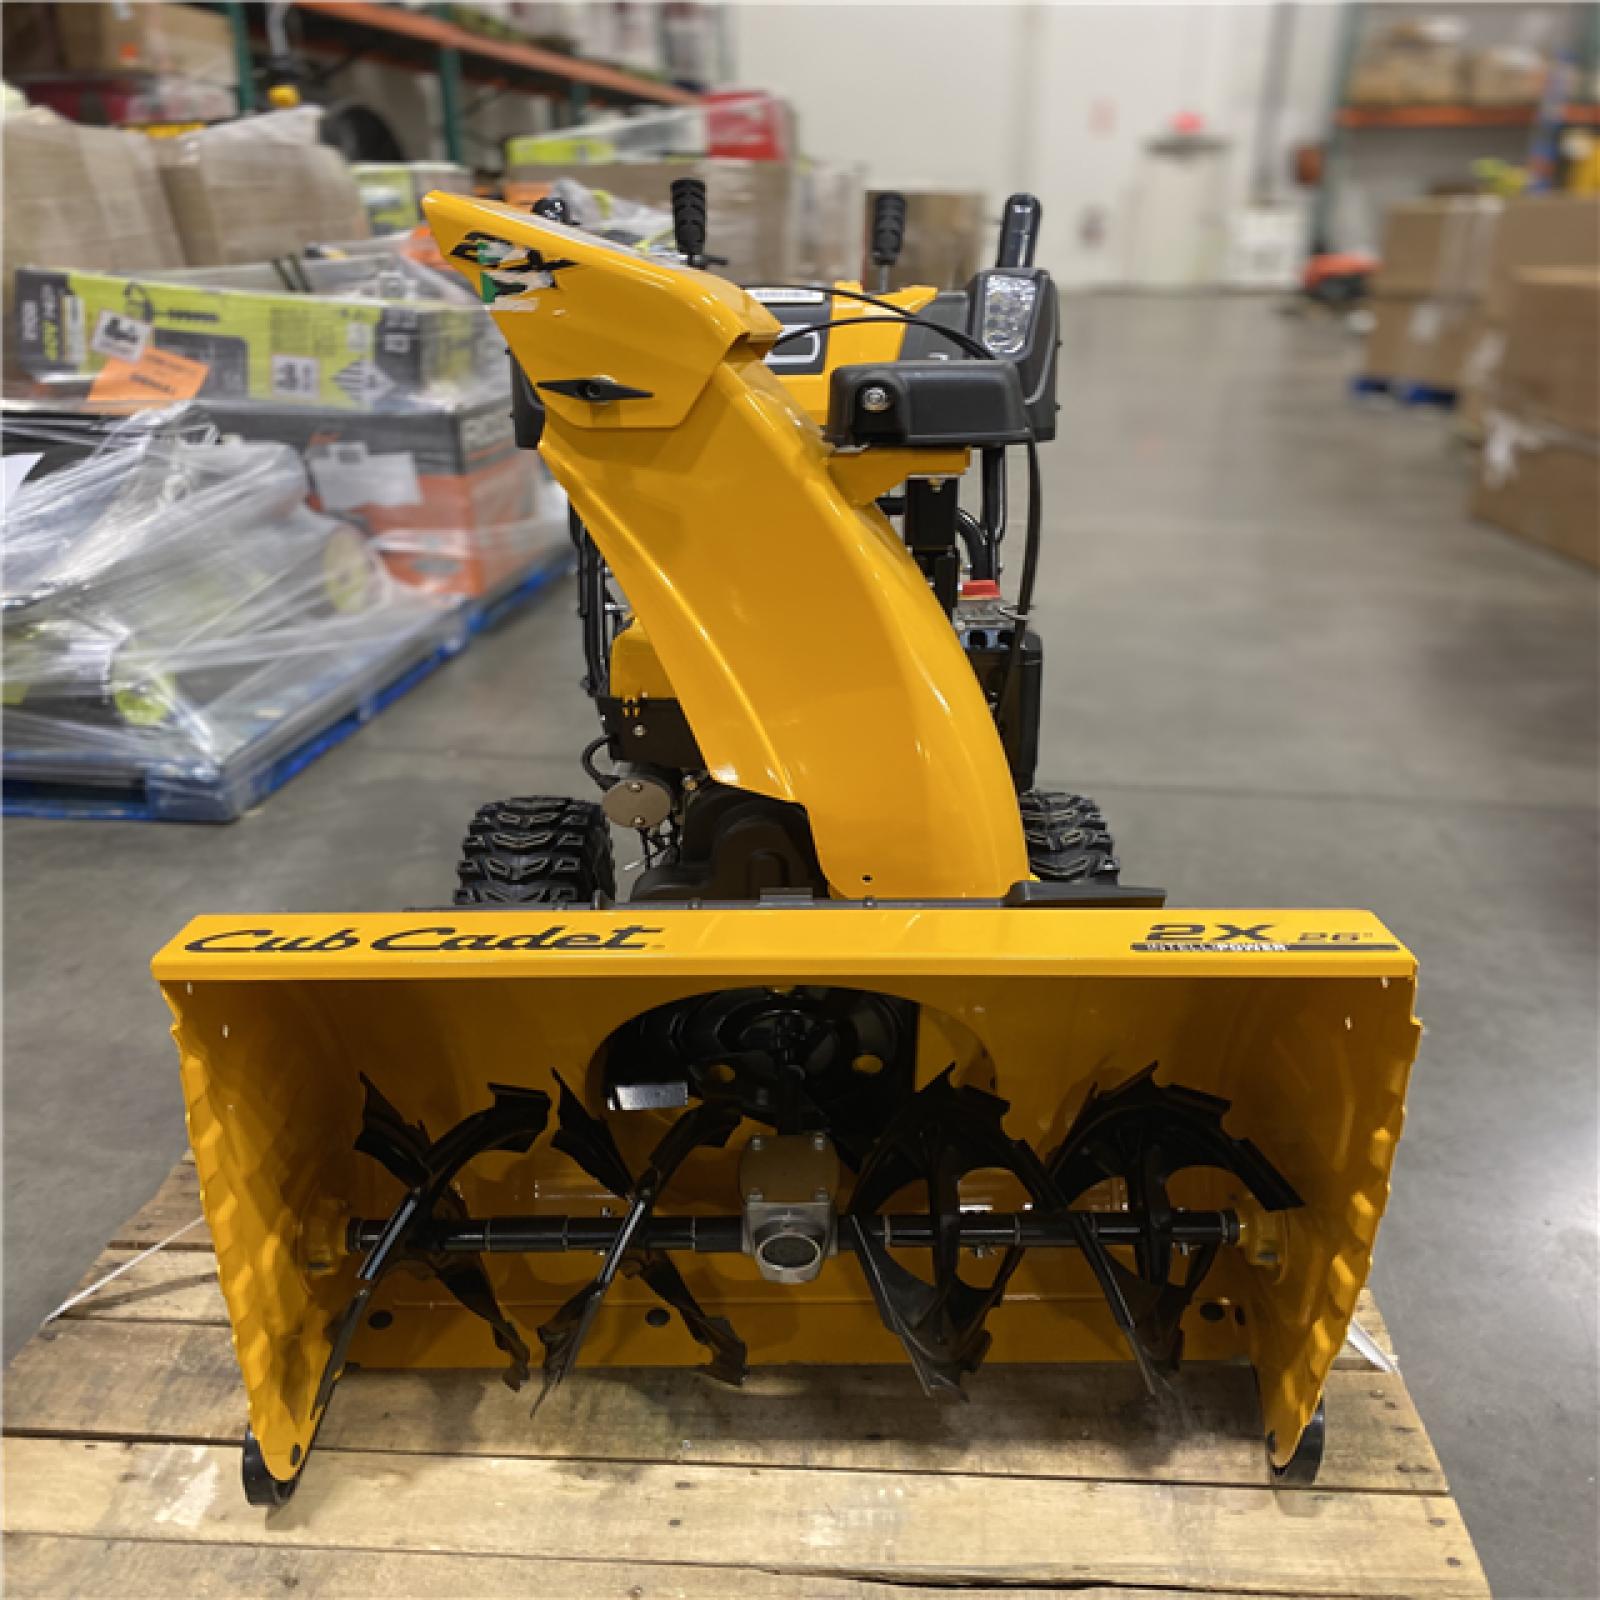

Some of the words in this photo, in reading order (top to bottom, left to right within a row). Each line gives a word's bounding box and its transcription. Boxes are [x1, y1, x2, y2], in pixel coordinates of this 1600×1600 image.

[184, 927, 361, 952] Cub
[369, 925, 665, 951] Cadet
[1146, 924, 1276, 941] 2X
